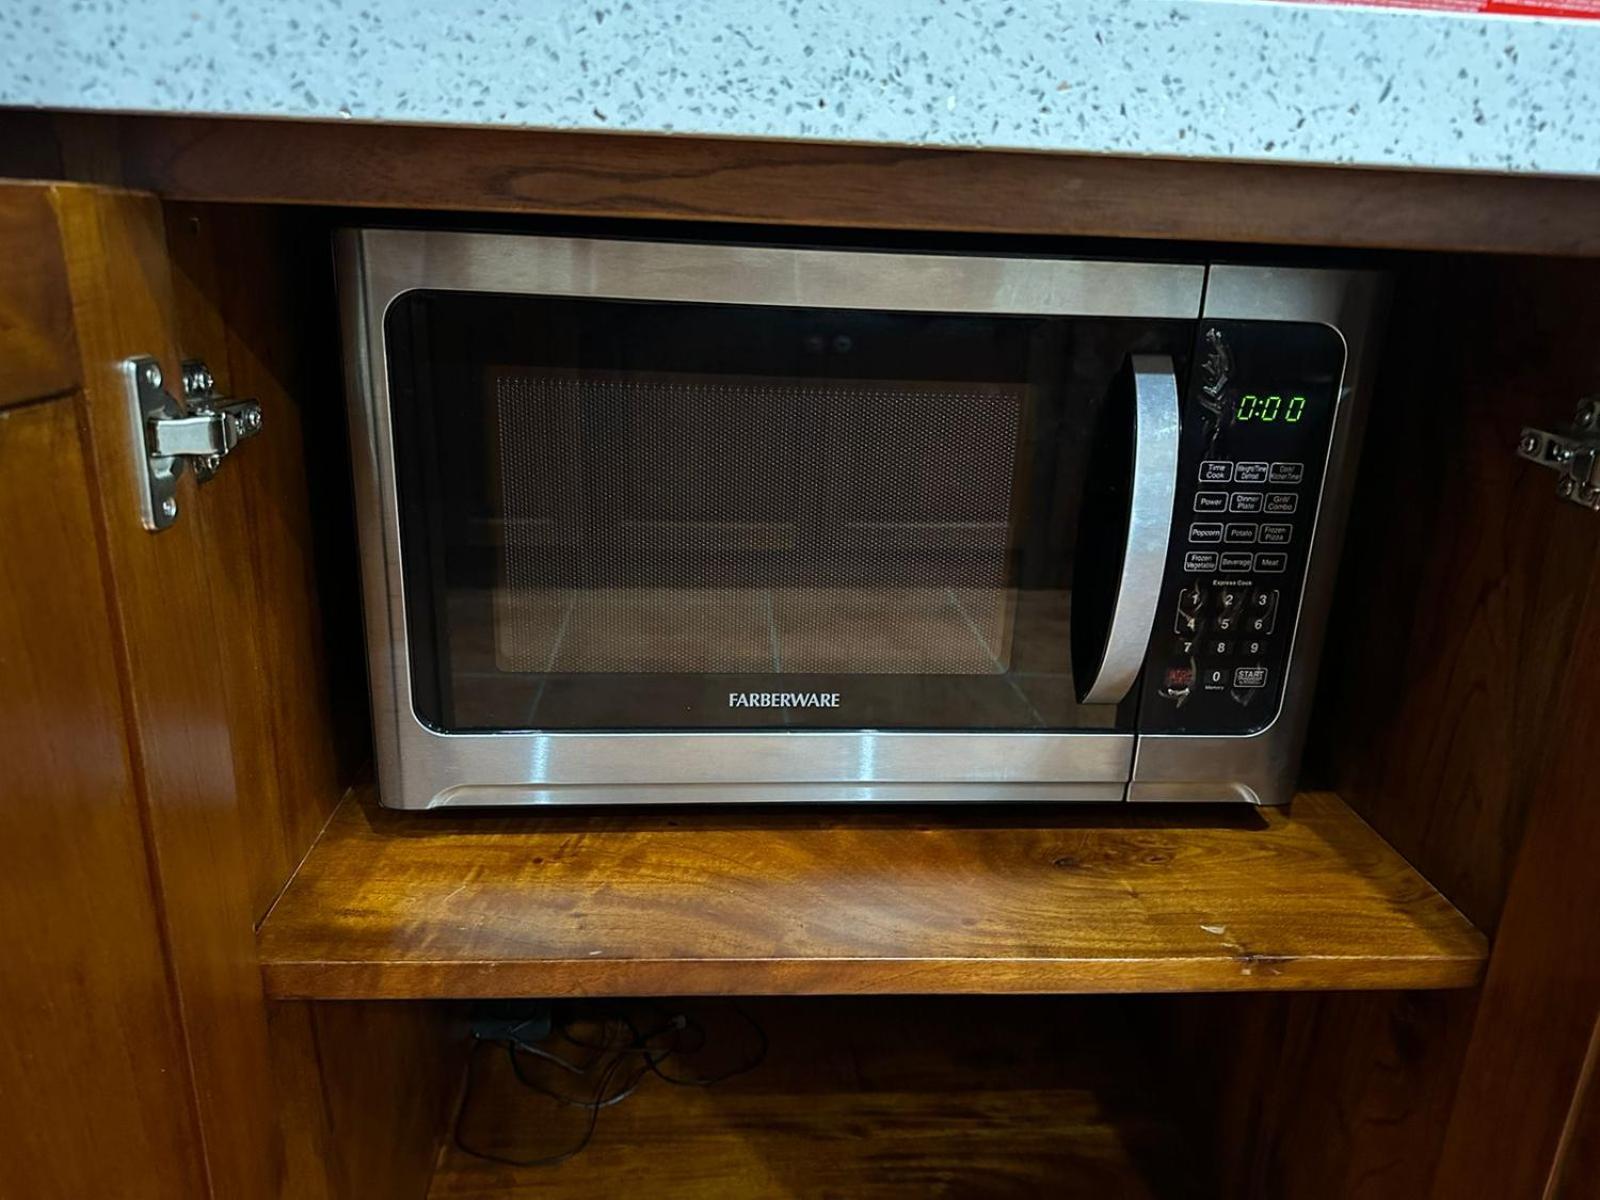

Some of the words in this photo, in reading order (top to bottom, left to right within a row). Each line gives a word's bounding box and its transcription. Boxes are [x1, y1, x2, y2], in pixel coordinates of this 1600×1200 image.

[1236, 395, 1306, 421] 0:00
[1192, 529, 1220, 537] Popcorn
[1192, 594, 1198, 604] 1
[1225, 594, 1233, 605] 2
[1259, 594, 1267, 605] 3
[1187, 618, 1195, 628] 4
[1221, 619, 1229, 629] 5
[1254, 620, 1262, 629] 6
[1184, 642, 1192, 652] 7
[1217, 642, 1225, 653] 8
[1250, 643, 1258, 653] 9
[1212, 672, 1220, 682] 0
[728, 693, 840, 708] FARBERWARE
